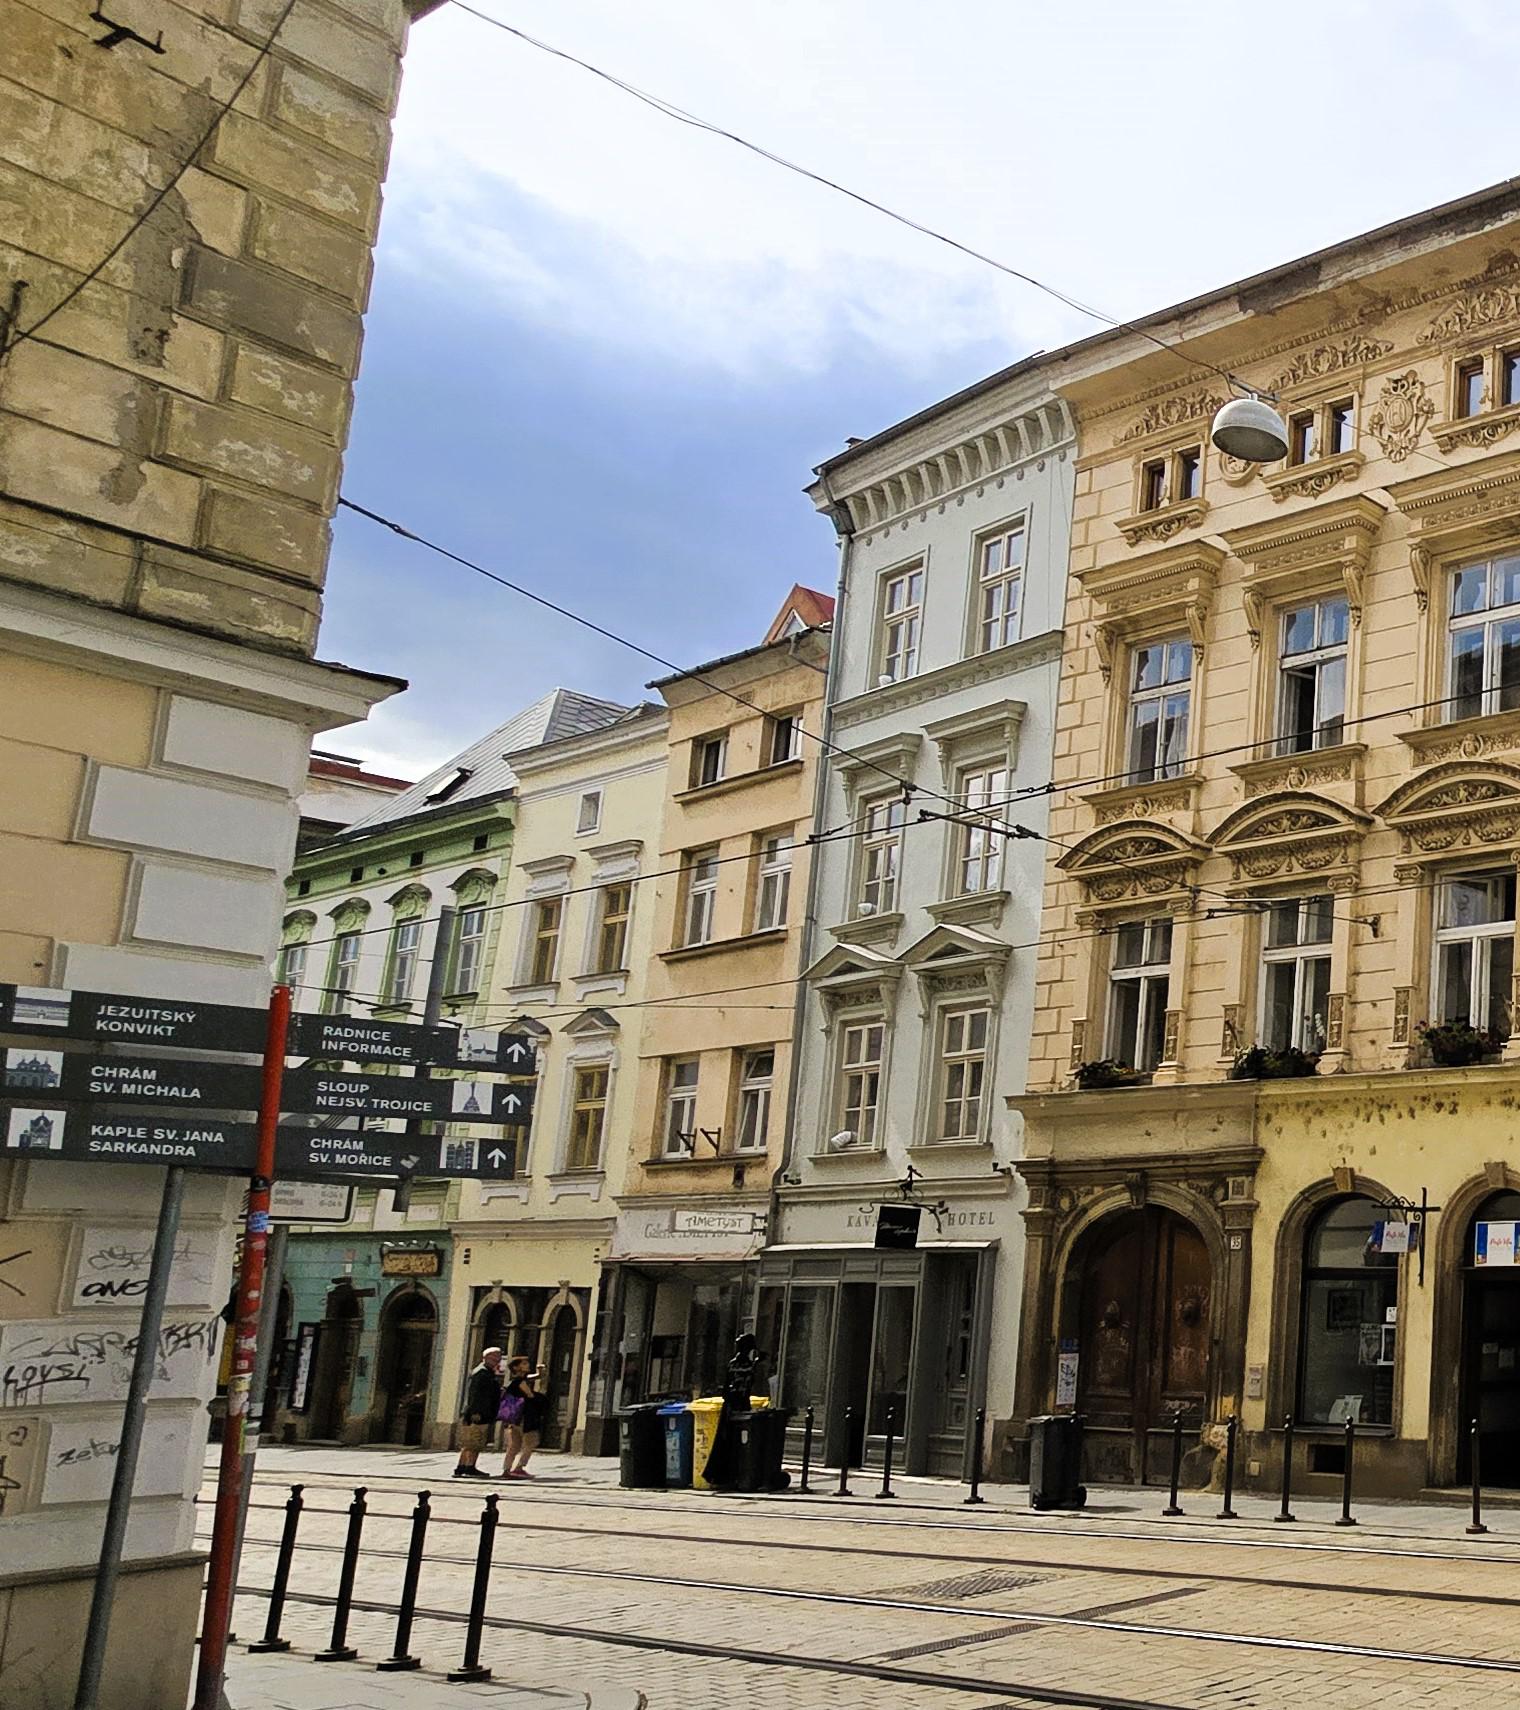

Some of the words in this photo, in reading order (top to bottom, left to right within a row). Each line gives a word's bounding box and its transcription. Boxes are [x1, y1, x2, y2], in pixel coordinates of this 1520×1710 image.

[97, 1005, 197, 1023] JEZUITSKÝ
[95, 1020, 175, 1036] KONVIKT
[323, 1025, 392, 1042] RADNICE
[321, 1040, 412, 1058] INFORMACE
[91, 1065, 157, 1080] CHRÁM
[89, 1081, 117, 1094] SV.
[121, 1084, 201, 1099] MICHALA
[317, 1081, 370, 1093] SLOUP
[316, 1095, 367, 1109] NEJSV.
[371, 1098, 433, 1112] TROJICE
[91, 1125, 148, 1139] KAPLE
[153, 1128, 179, 1141] SV.
[182, 1130, 225, 1143] JANA
[89, 1140, 196, 1157] SARKANDRA
[310, 1137, 364, 1150] CHRÁM
[309, 1152, 331, 1164] SV.
[335, 1153, 392, 1167] MOŘICE
[947, 1211, 996, 1226] HOTEL
[1231, 1237, 1241, 1248] 35
